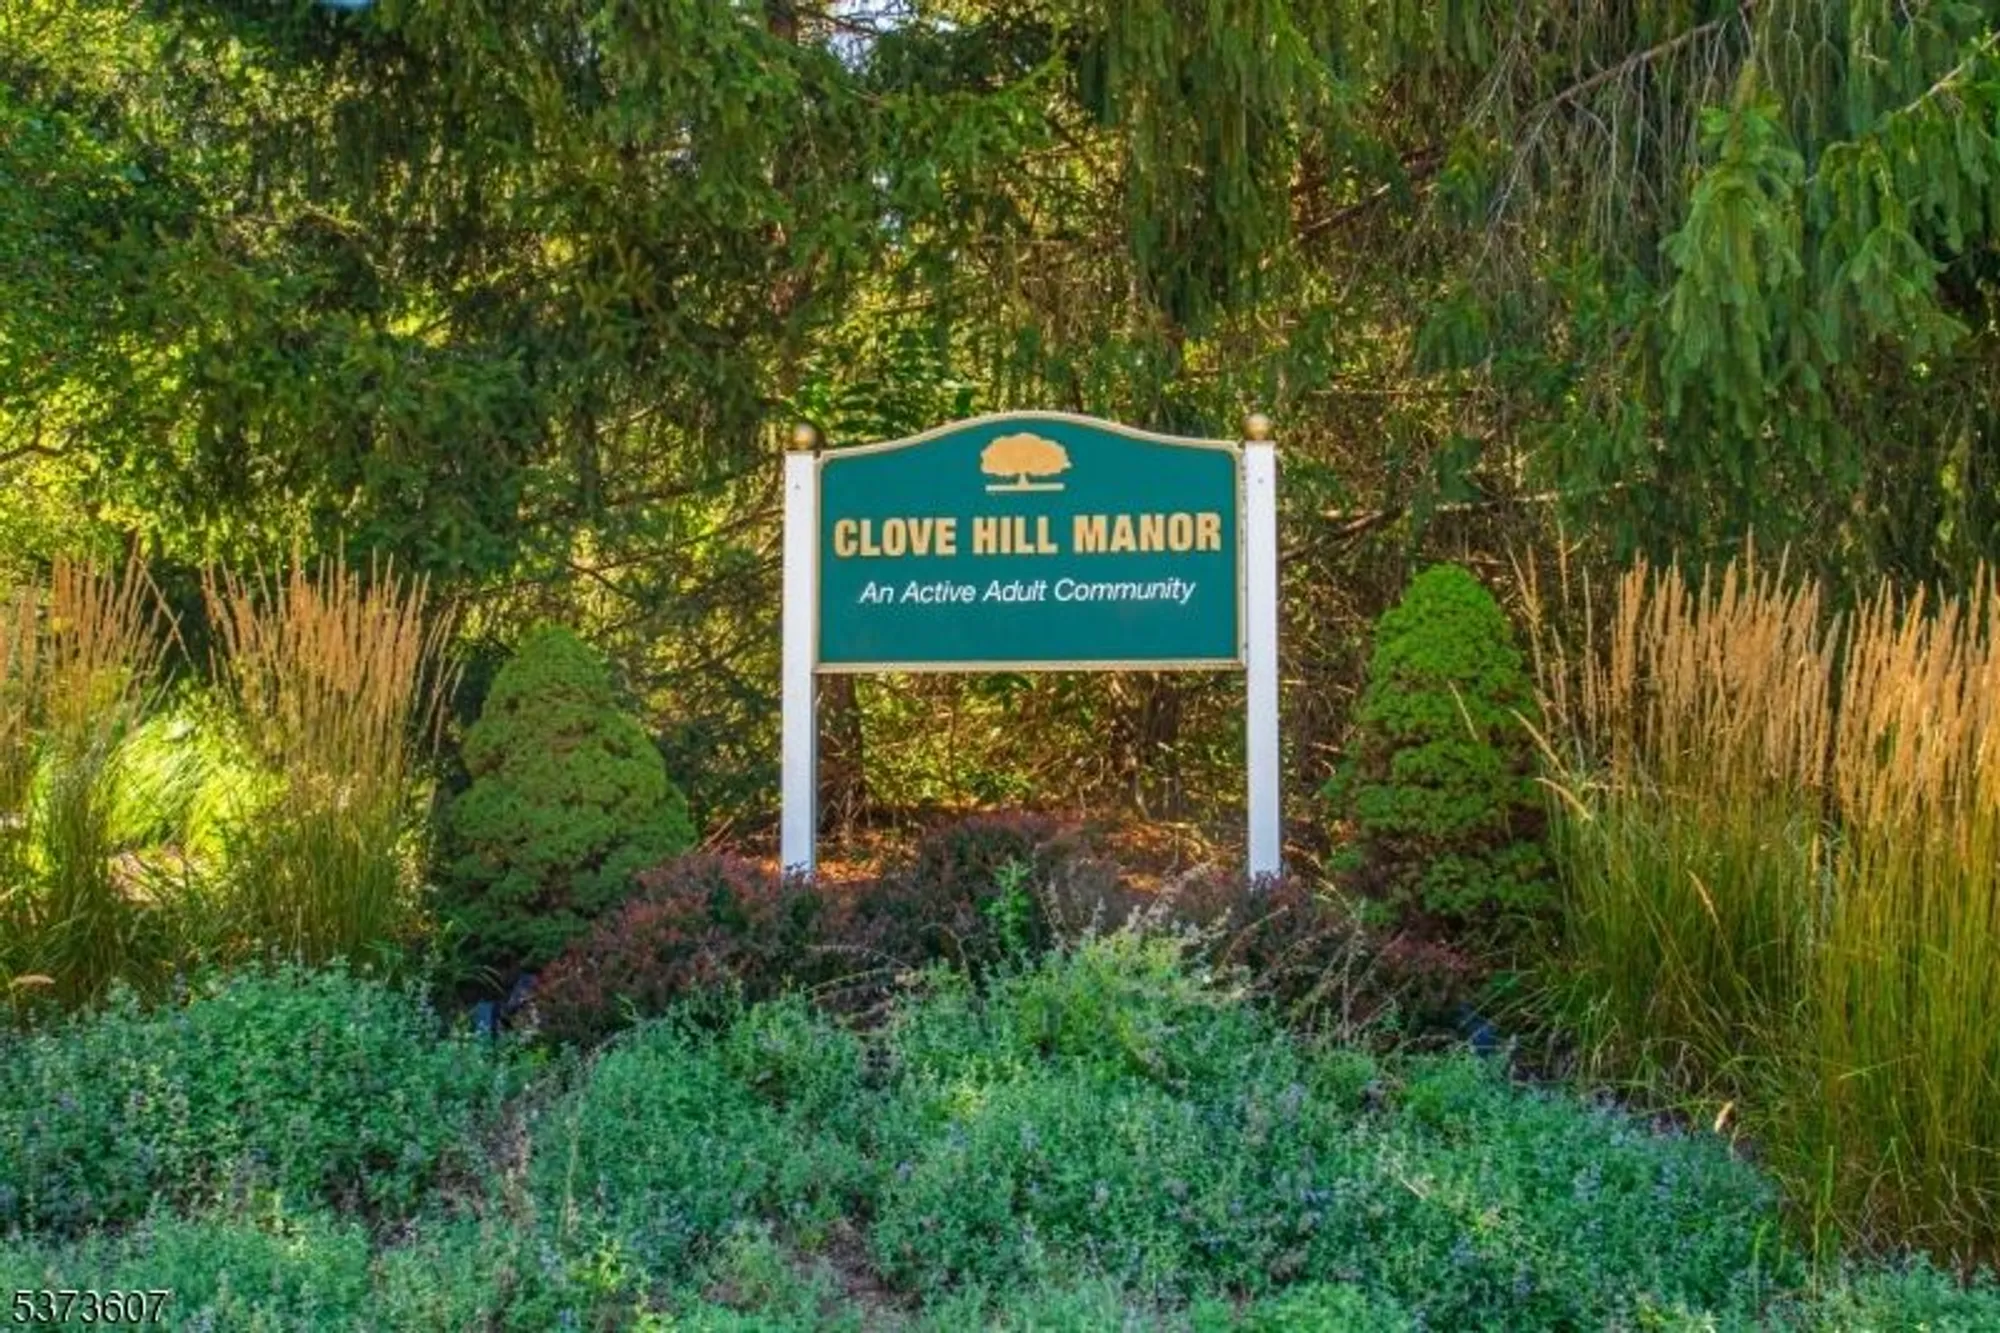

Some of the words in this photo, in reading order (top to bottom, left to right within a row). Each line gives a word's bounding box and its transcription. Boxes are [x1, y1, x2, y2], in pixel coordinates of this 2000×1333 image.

[833, 517, 957, 558] CLOVE
[972, 515, 1059, 555] HILL
[1073, 512, 1222, 554] MANOR
[859, 581, 893, 603] An
[901, 580, 976, 604] Active
[982, 580, 1047, 602] Adult
[1053, 577, 1196, 605] Community
